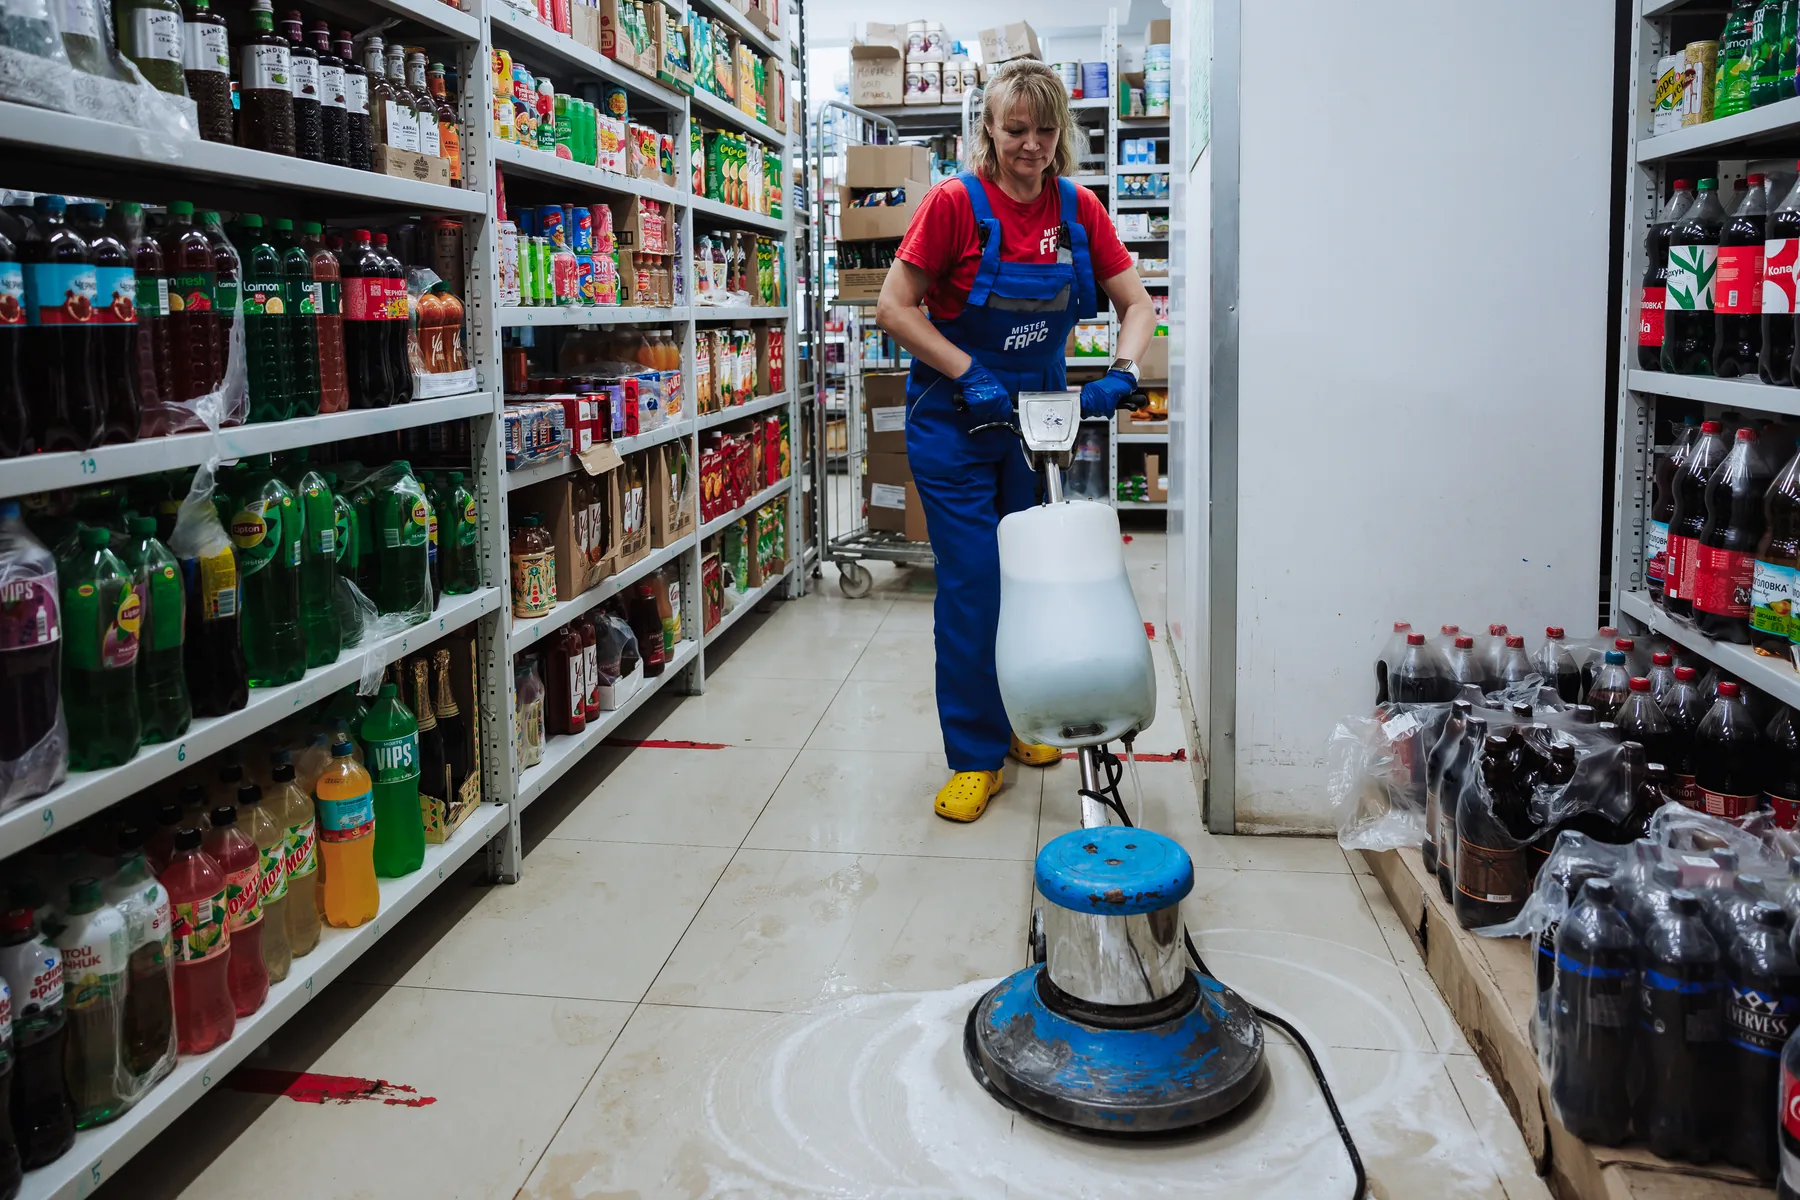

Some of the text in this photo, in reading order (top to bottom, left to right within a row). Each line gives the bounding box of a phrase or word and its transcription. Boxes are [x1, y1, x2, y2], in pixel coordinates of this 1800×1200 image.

[1768, 264, 1793, 276] Кола
[243, 281, 280, 292] Laimon
[1011, 320, 1046, 335] MISTER
[80, 457, 98, 475] 19
[233, 525, 261, 534] Lipton
[1756, 611, 1783, 623] ДЮШЕС
[177, 743, 186, 762] 6
[375, 742, 413, 771] VIPS
[1731, 1004, 1789, 1037] VERVESS
[202, 1068, 211, 1087] 6
[90, 1159, 103, 1186] 5
